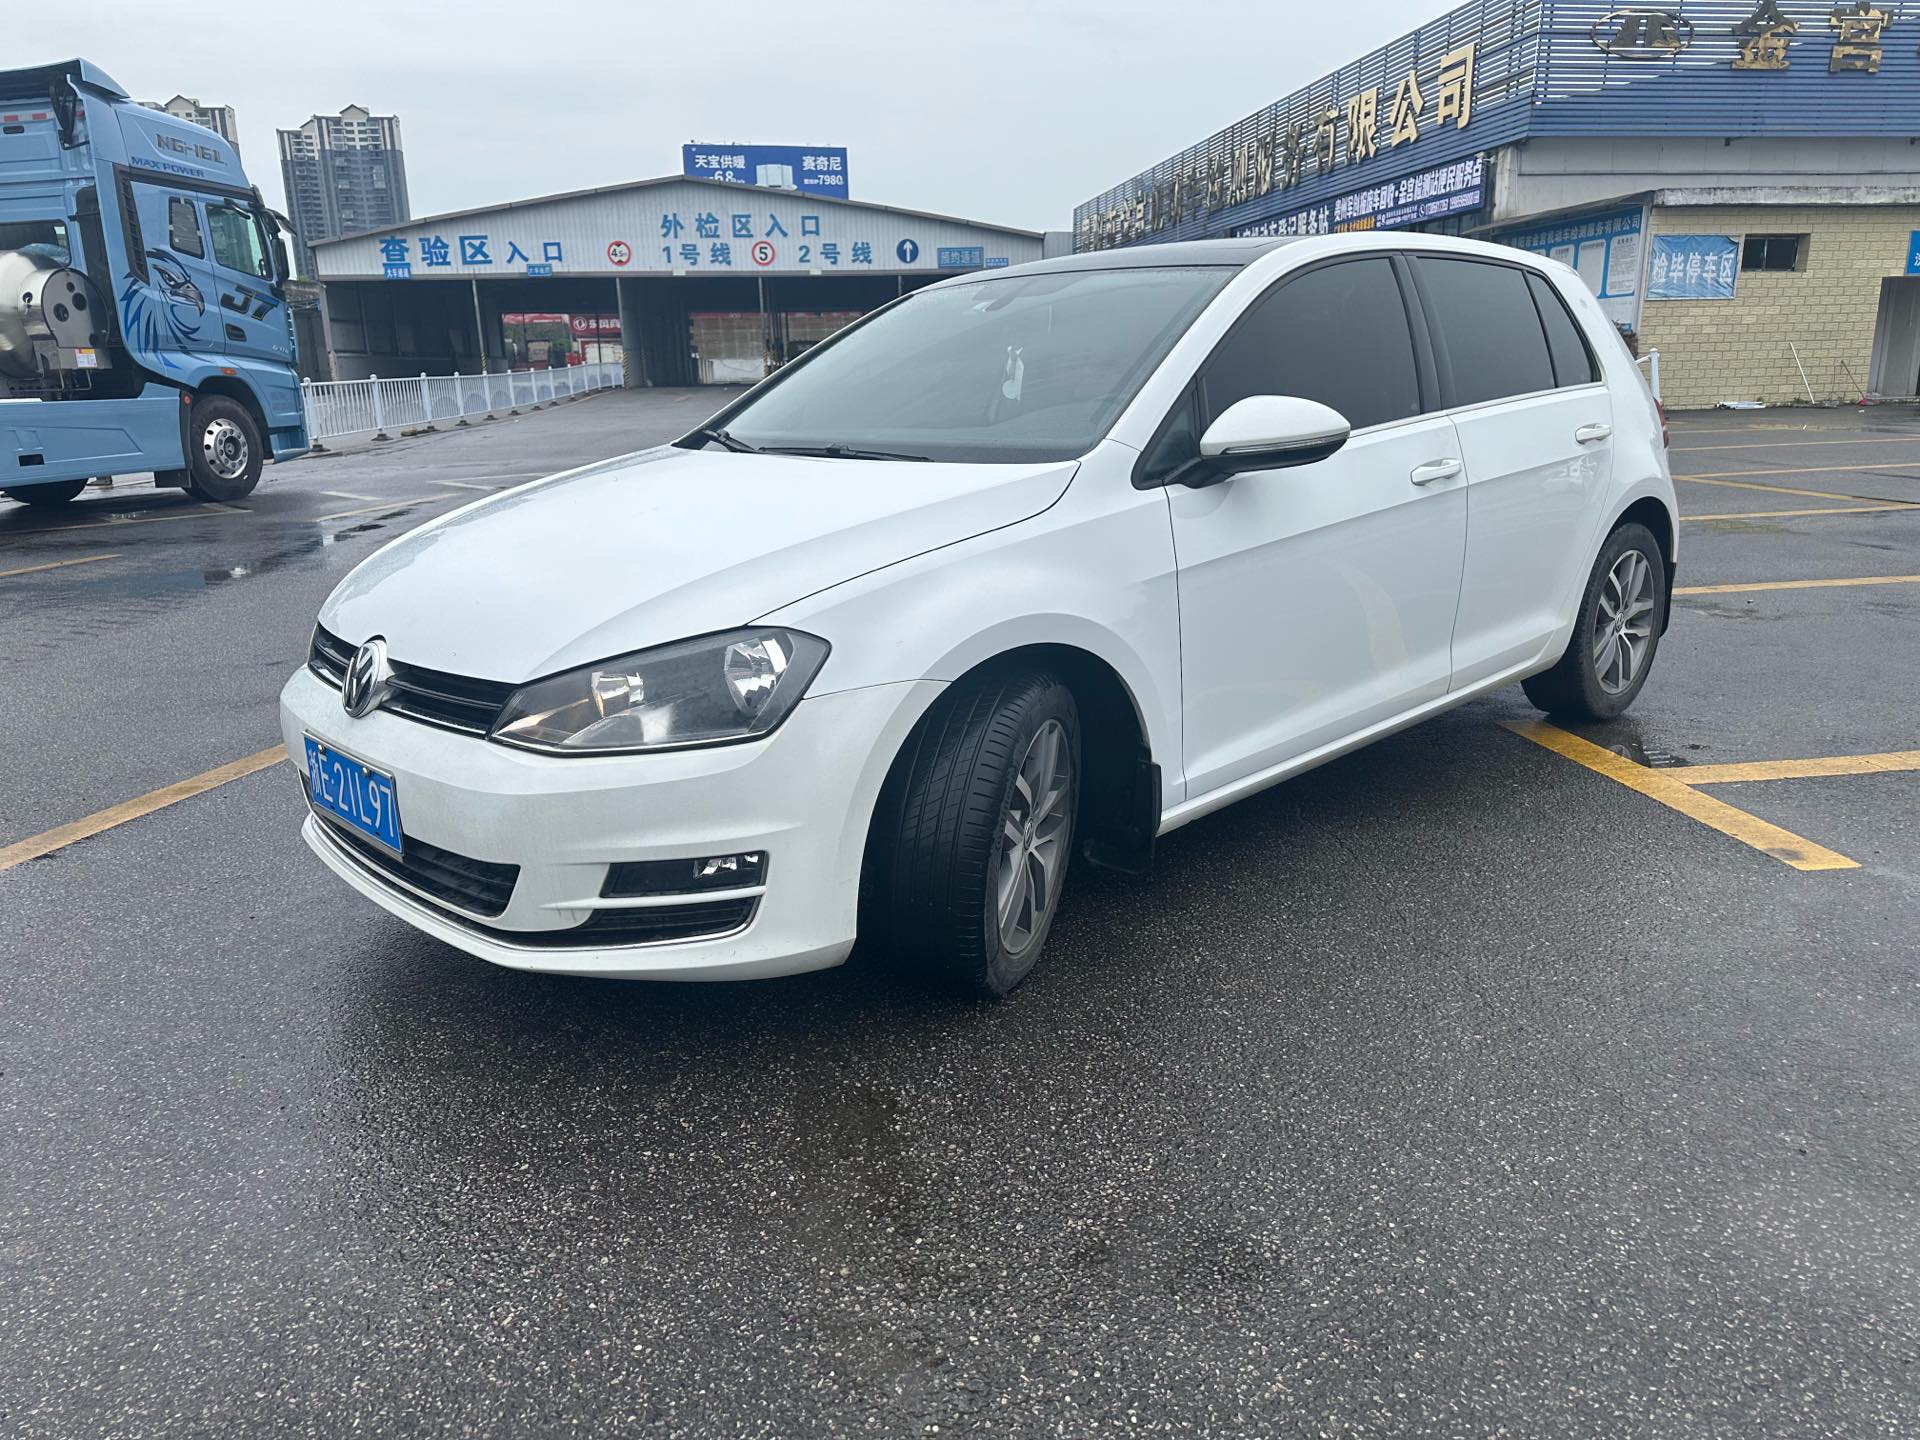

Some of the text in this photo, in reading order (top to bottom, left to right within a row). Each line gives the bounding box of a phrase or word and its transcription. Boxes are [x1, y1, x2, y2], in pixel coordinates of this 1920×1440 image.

[131, 156, 205, 178] MAX POWER
[695, 154, 747, 170] 天宝供暖
[802, 156, 842, 171] 赛奇尼
[660, 212, 820, 239] 外检区入口
[378, 235, 565, 267] 查验区入口
[662, 242, 732, 266] 1号线
[759, 246, 769, 262] 5
[798, 241, 872, 265] 2号线
[1653, 252, 1735, 284] 检毕停车区
[220, 284, 280, 321] J7
